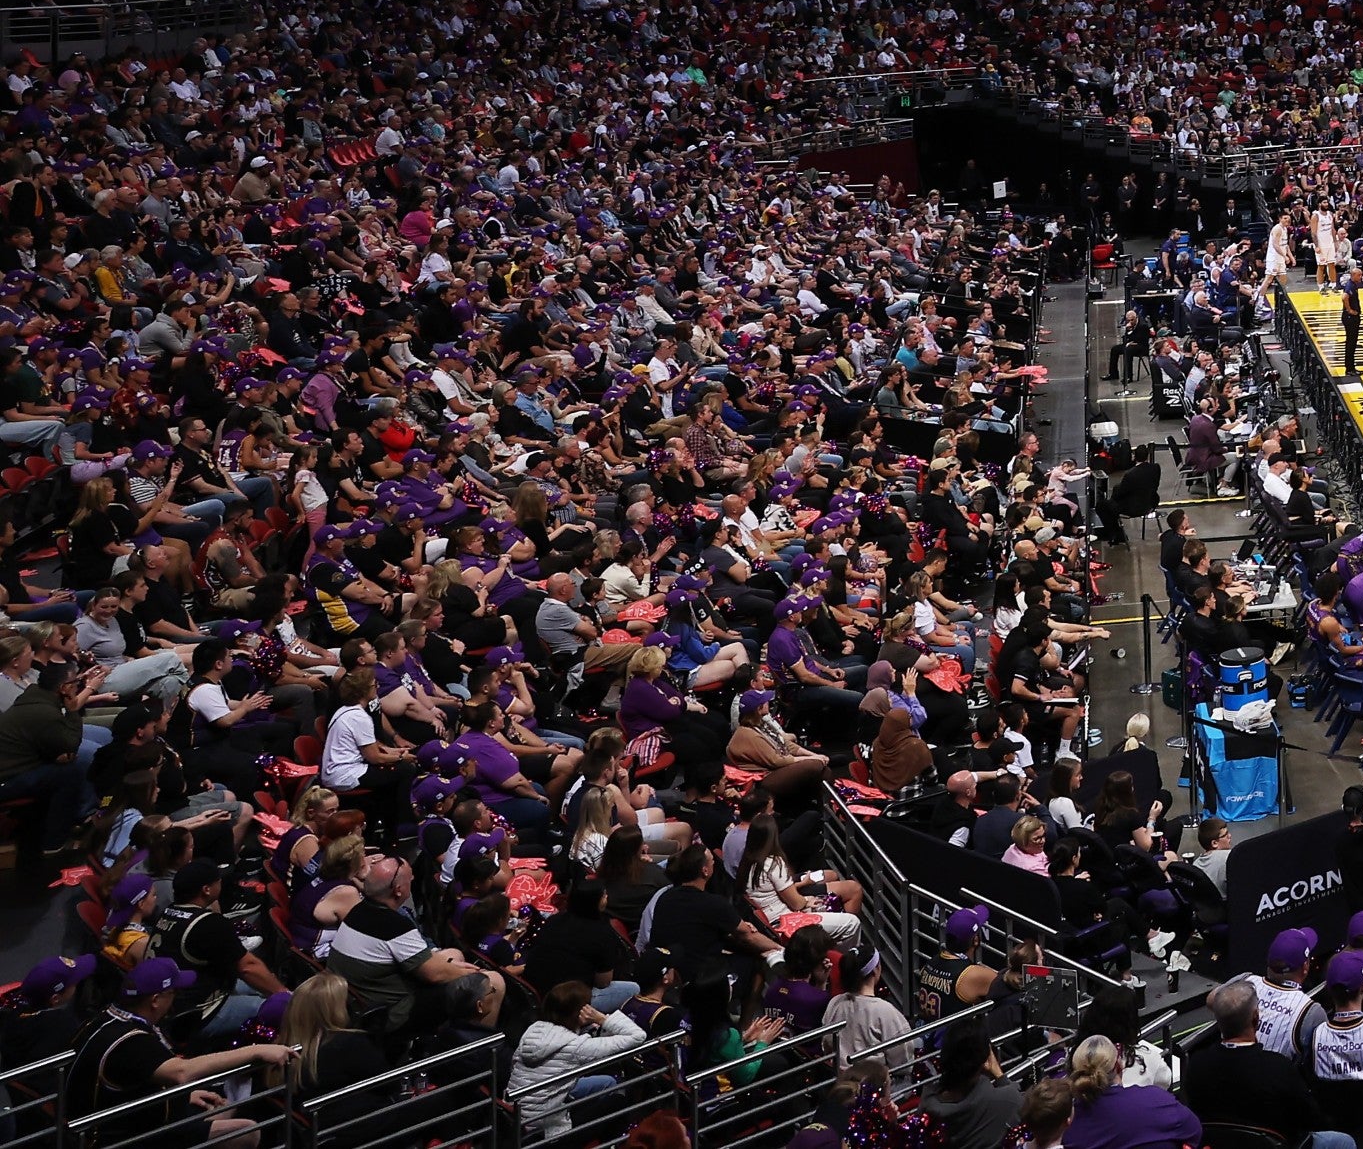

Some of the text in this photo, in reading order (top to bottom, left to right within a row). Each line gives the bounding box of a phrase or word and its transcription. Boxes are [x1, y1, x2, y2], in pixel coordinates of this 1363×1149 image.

[1255, 869, 1343, 915] ACORN
[1255, 904, 1292, 923] MANAGED
[1270, 1001, 1293, 1016] Bank
[1317, 1042, 1348, 1053] Beyond
[1331, 1061, 1363, 1075] ADAMS
